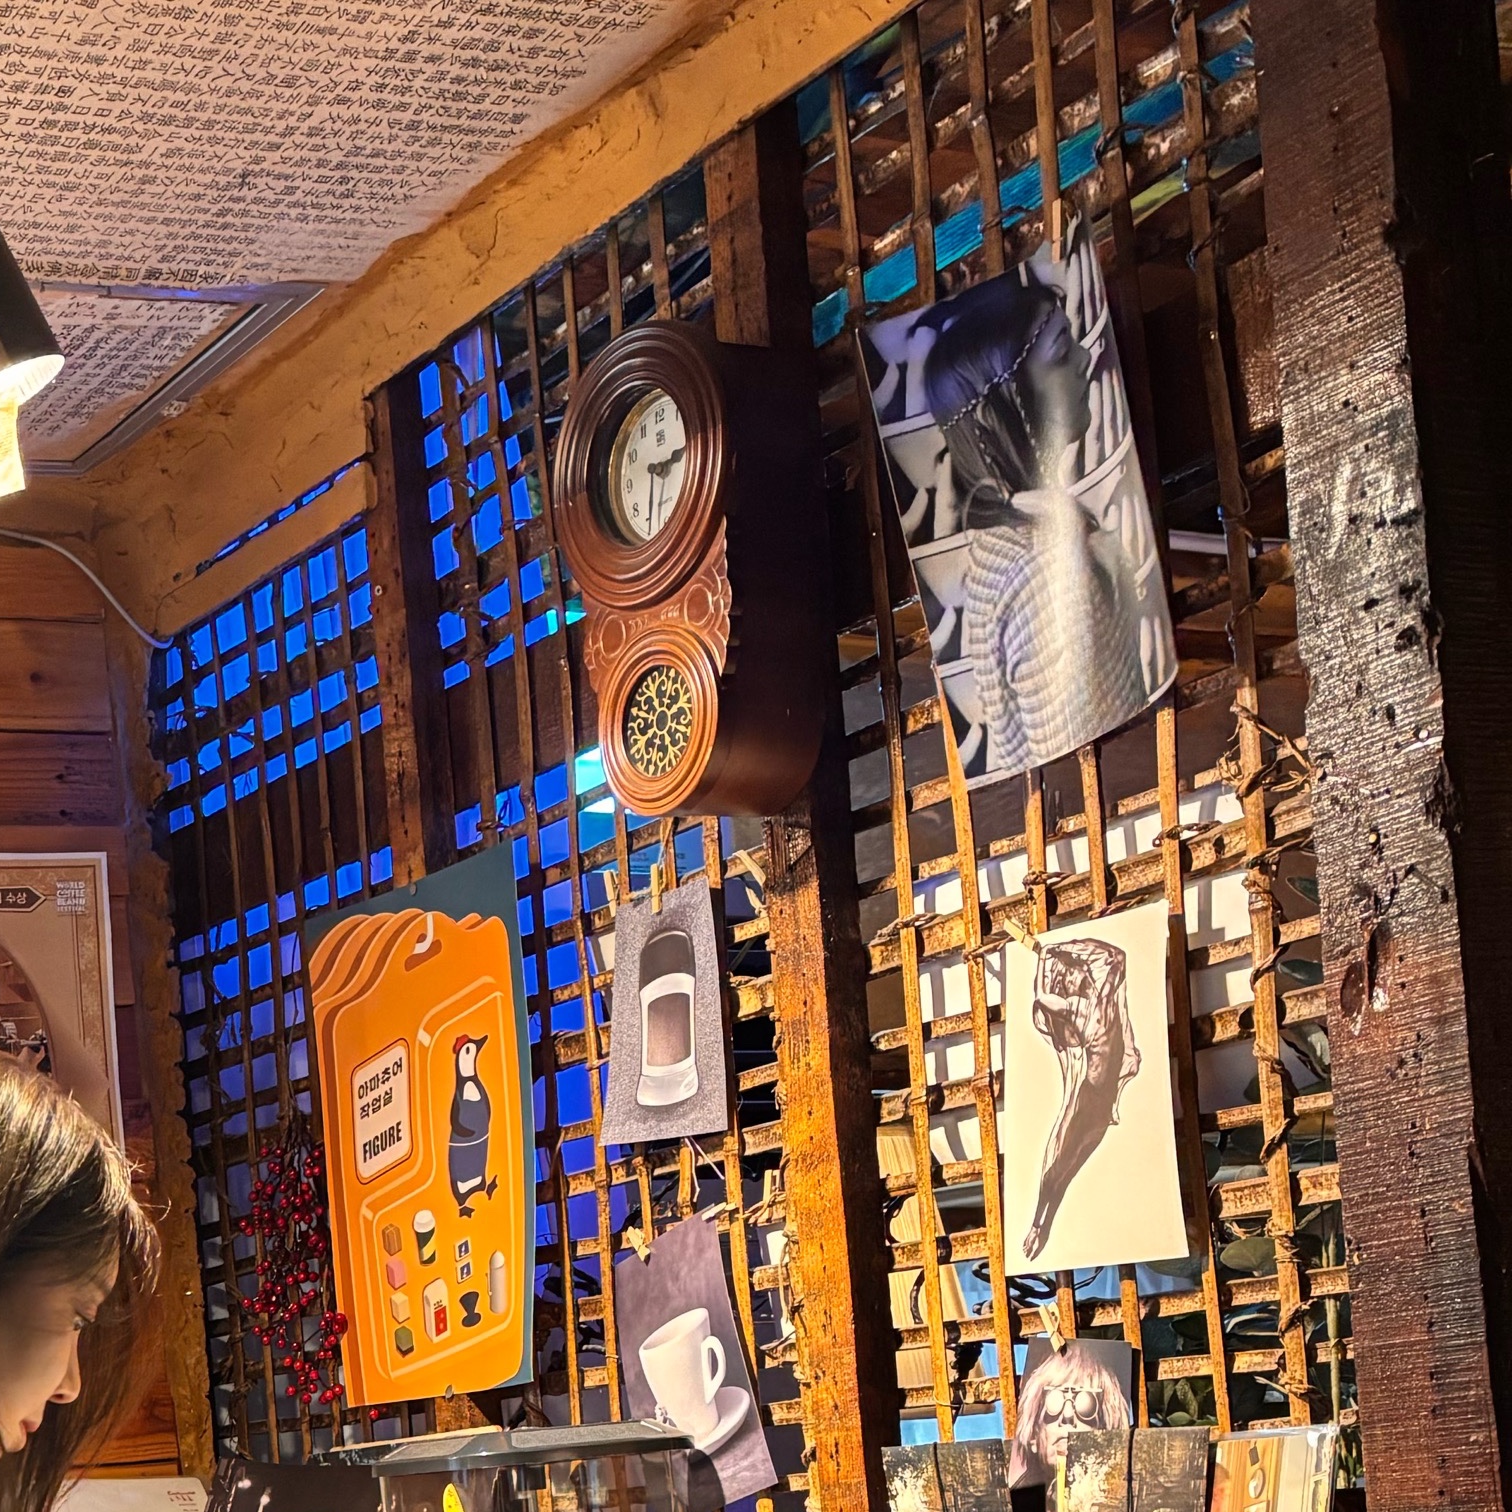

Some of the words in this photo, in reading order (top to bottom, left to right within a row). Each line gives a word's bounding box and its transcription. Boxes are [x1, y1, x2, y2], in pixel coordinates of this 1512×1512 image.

[5, 891, 27, 904] 수상
[358, 1057, 403, 1099] 아마츄어
[360, 1086, 393, 1120] 작업실
[363, 1120, 403, 1163] FIGURE
